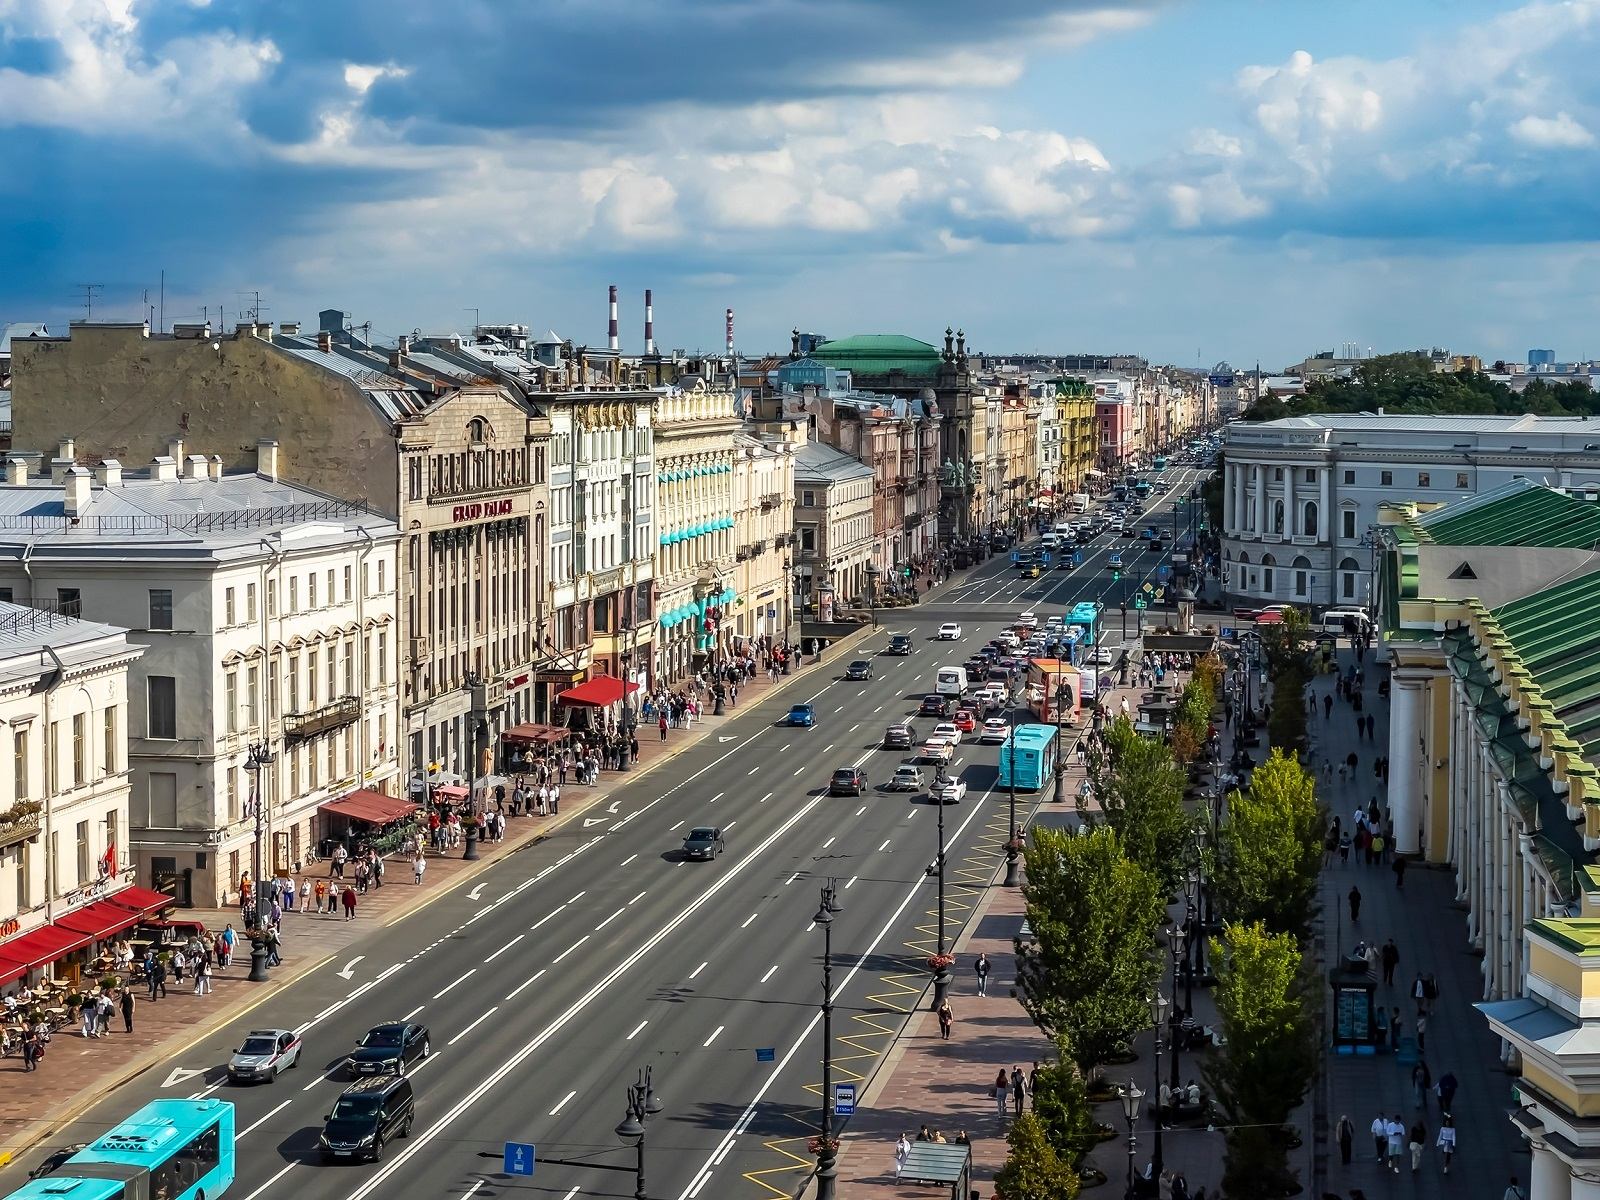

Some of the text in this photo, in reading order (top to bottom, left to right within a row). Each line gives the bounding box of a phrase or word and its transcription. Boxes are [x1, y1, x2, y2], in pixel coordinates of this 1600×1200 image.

[453, 499, 512, 523] GRAND PALACE
[239, 1056, 258, 1064] Z
